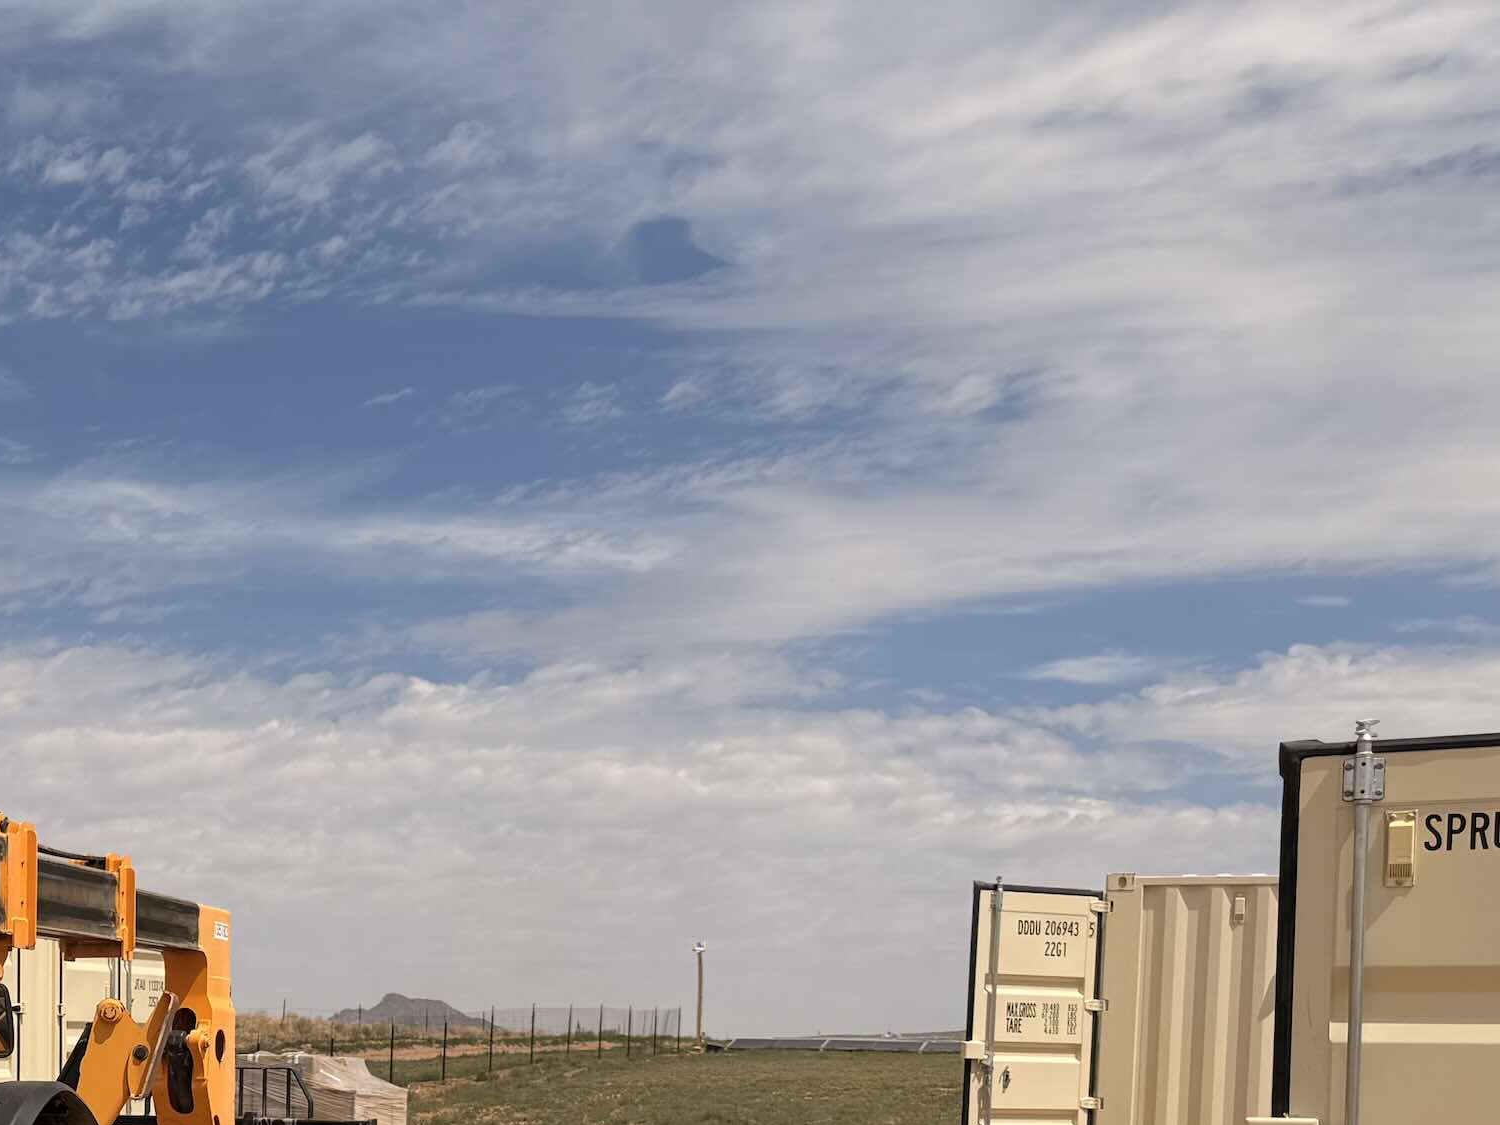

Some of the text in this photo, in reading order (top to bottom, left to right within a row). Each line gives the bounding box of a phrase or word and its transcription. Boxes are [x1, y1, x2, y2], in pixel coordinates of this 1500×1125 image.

[1017, 919, 1041, 936] DDDU
[1044, 920, 1080, 937] 206943
[1044, 941, 1068, 957] 22G1
[1005, 1018, 1023, 1034] TARE
